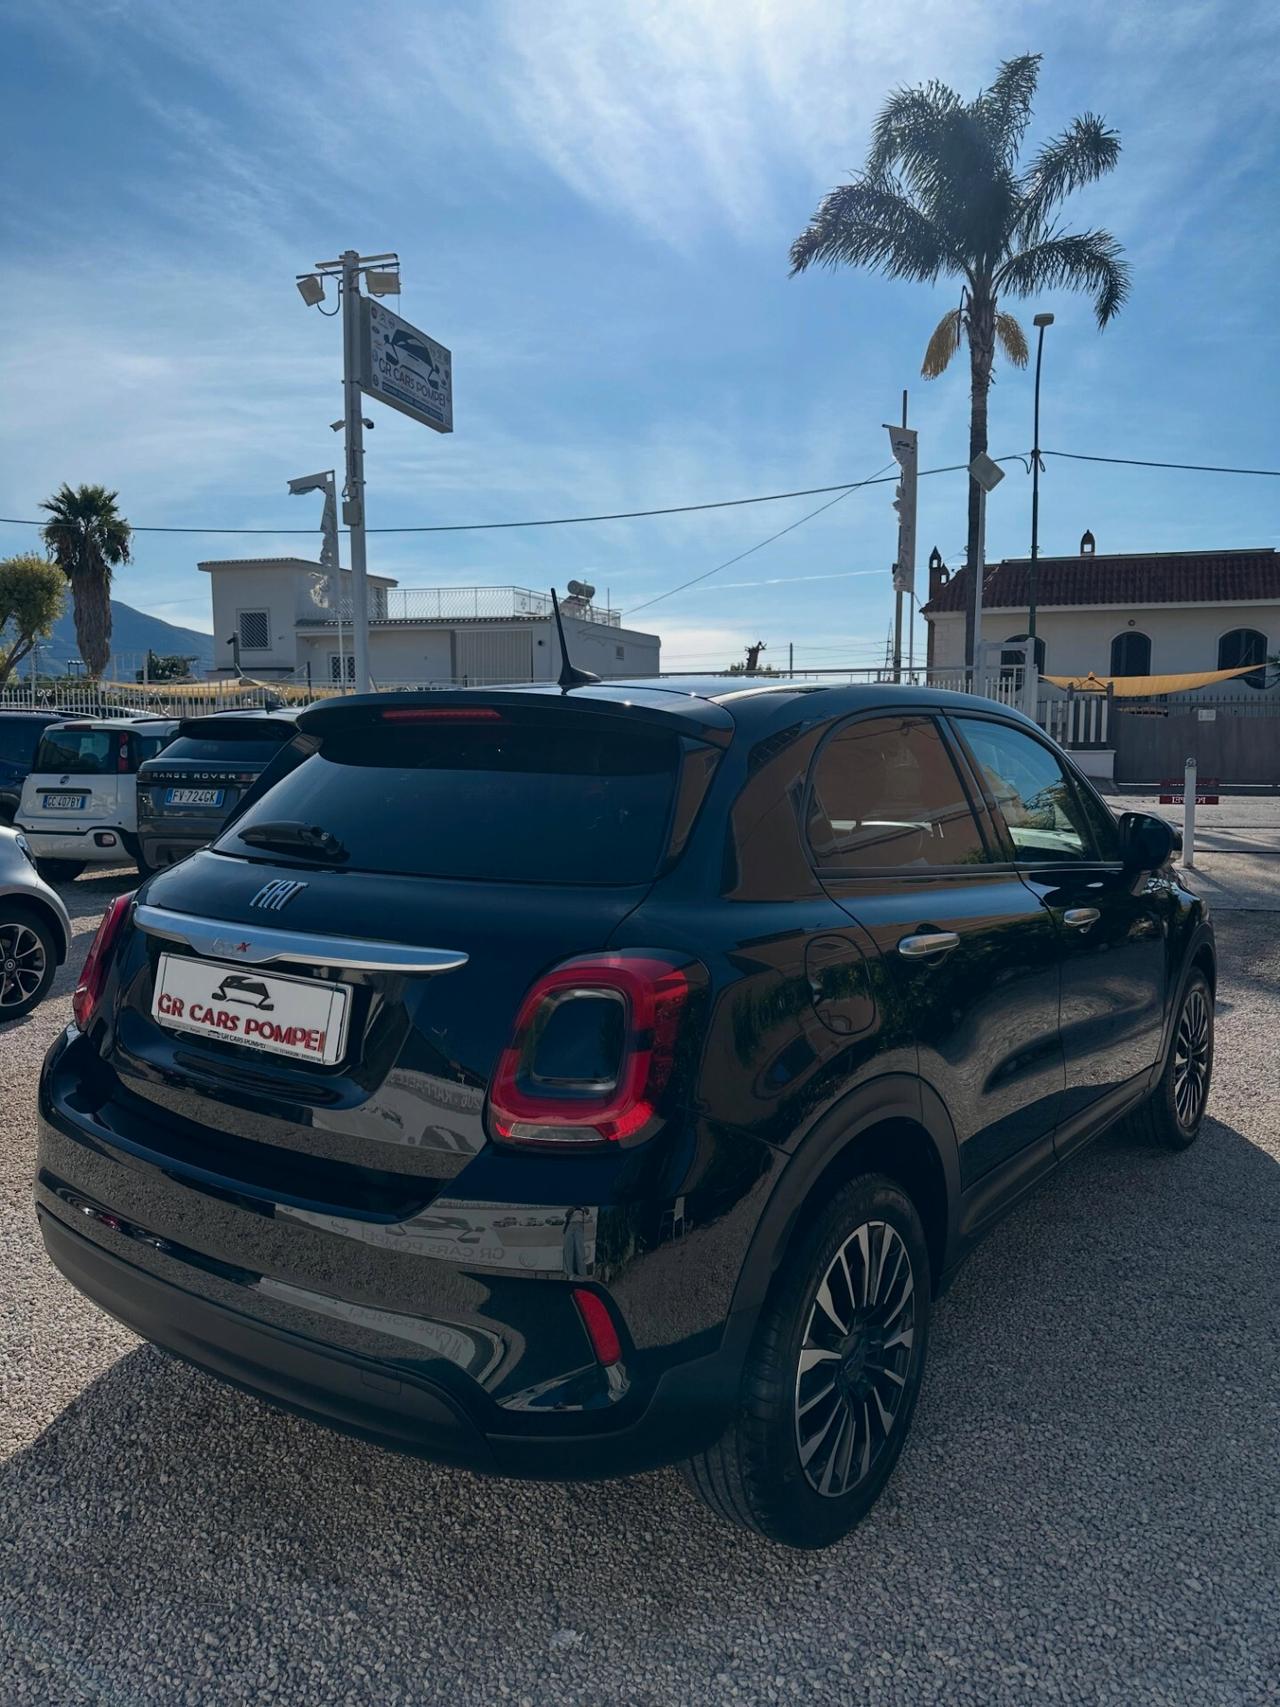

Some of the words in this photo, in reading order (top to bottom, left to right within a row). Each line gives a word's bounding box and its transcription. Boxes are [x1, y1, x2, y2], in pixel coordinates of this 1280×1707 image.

[379, 358, 391, 377] GR
[394, 368, 414, 389] CARS
[416, 381, 445, 408] POMPEI
[153, 772, 188, 780] RANGE
[194, 772, 237, 780] ROVER
[249, 879, 309, 911] FIAT
[158, 992, 185, 1018] GR
[189, 1003, 241, 1031] CARS
[244, 1018, 325, 1053] POMPEI
